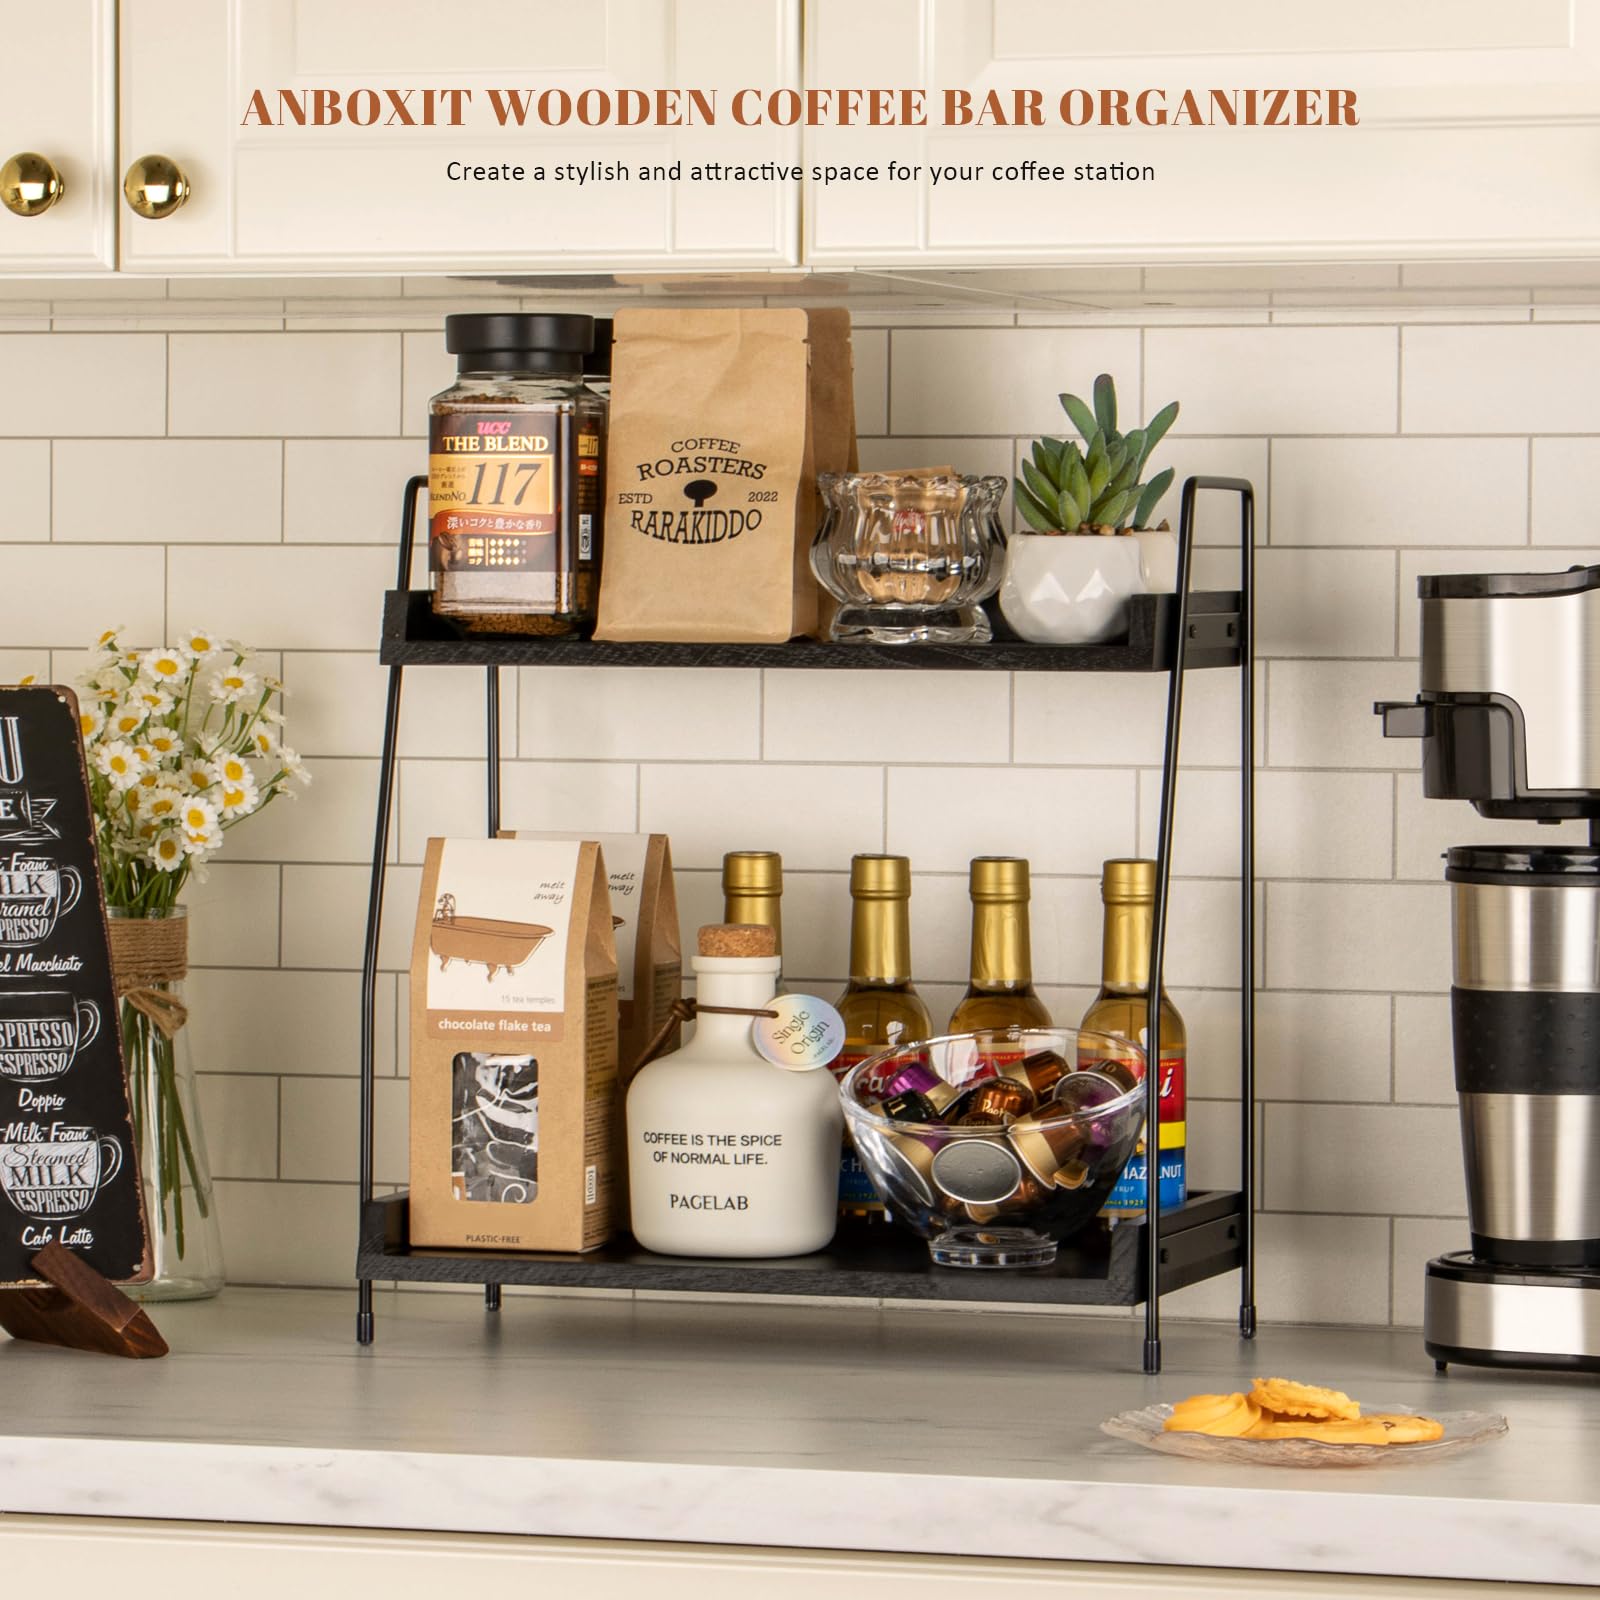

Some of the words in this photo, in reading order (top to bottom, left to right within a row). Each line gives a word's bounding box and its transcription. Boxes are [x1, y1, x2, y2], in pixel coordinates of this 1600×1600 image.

[443, 436, 480, 451] THE
[484, 436, 548, 451] BLEND
[671, 438, 741, 454] COFFEE
[637, 456, 767, 481] ROASTERS
[466, 462, 542, 506] 117
[618, 493, 653, 504] ESTD
[748, 491, 779, 502] 2022
[630, 508, 763, 544] RARAKIDDO
[11, 851, 49, 872] Foam
[0, 874, 48, 895] LK
[539, 880, 566, 889] melt
[610, 871, 636, 881] melt
[533, 892, 565, 904] away
[15, 952, 83, 972] Macchiato
[438, 1018, 495, 1032] chocolate
[498, 1019, 529, 1033] flake
[532, 1021, 552, 1033] tea
[771, 1010, 811, 1045] Single
[790, 1021, 831, 1055] Origin
[18, 1088, 66, 1113] Doppio
[4, 1121, 44, 1142] Milk
[50, 1121, 89, 1142] Foam
[643, 1131, 688, 1146] COFFEE
[691, 1134, 704, 1146] IS
[707, 1134, 737, 1147] THE
[740, 1134, 783, 1147] SPICE
[3, 1144, 90, 1167] Steamed
[653, 1150, 668, 1163] OF
[671, 1152, 731, 1165] NORMAL
[734, 1153, 769, 1166] LIFE.
[8, 1165, 91, 1187] MILK
[16, 1189, 90, 1213] ESPRESSO
[669, 1193, 750, 1212] PAGELAB
[59, 1225, 94, 1244] Latte
[465, 1233, 521, 1244] PLASTIC-FREE
